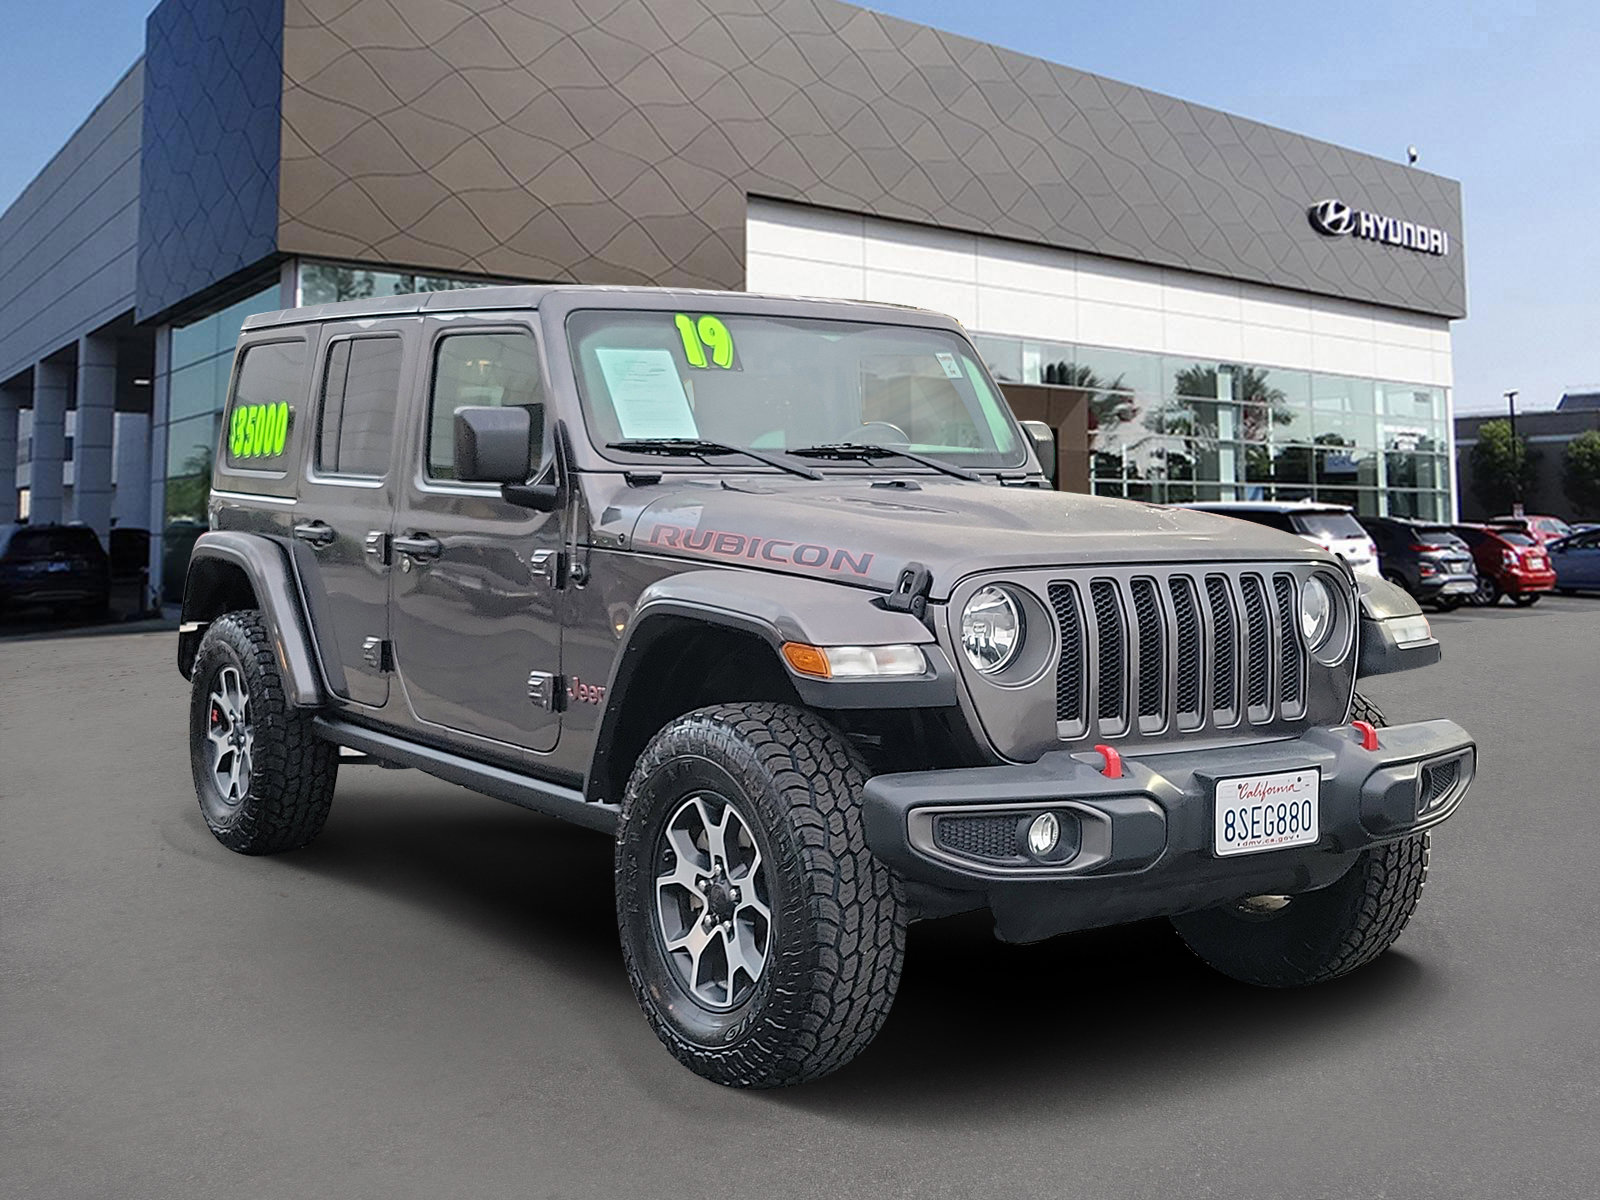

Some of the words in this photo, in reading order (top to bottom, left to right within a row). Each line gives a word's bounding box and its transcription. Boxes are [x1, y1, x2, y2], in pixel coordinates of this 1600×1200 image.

[1360, 210, 1449, 256] HYUNDAI
[674, 313, 735, 370] 19
[650, 524, 875, 577] RUBICON
[1239, 780, 1301, 803] California
[1225, 800, 1312, 842] 8SEG880
[1242, 836, 1294, 847] dmv.ca.gov
